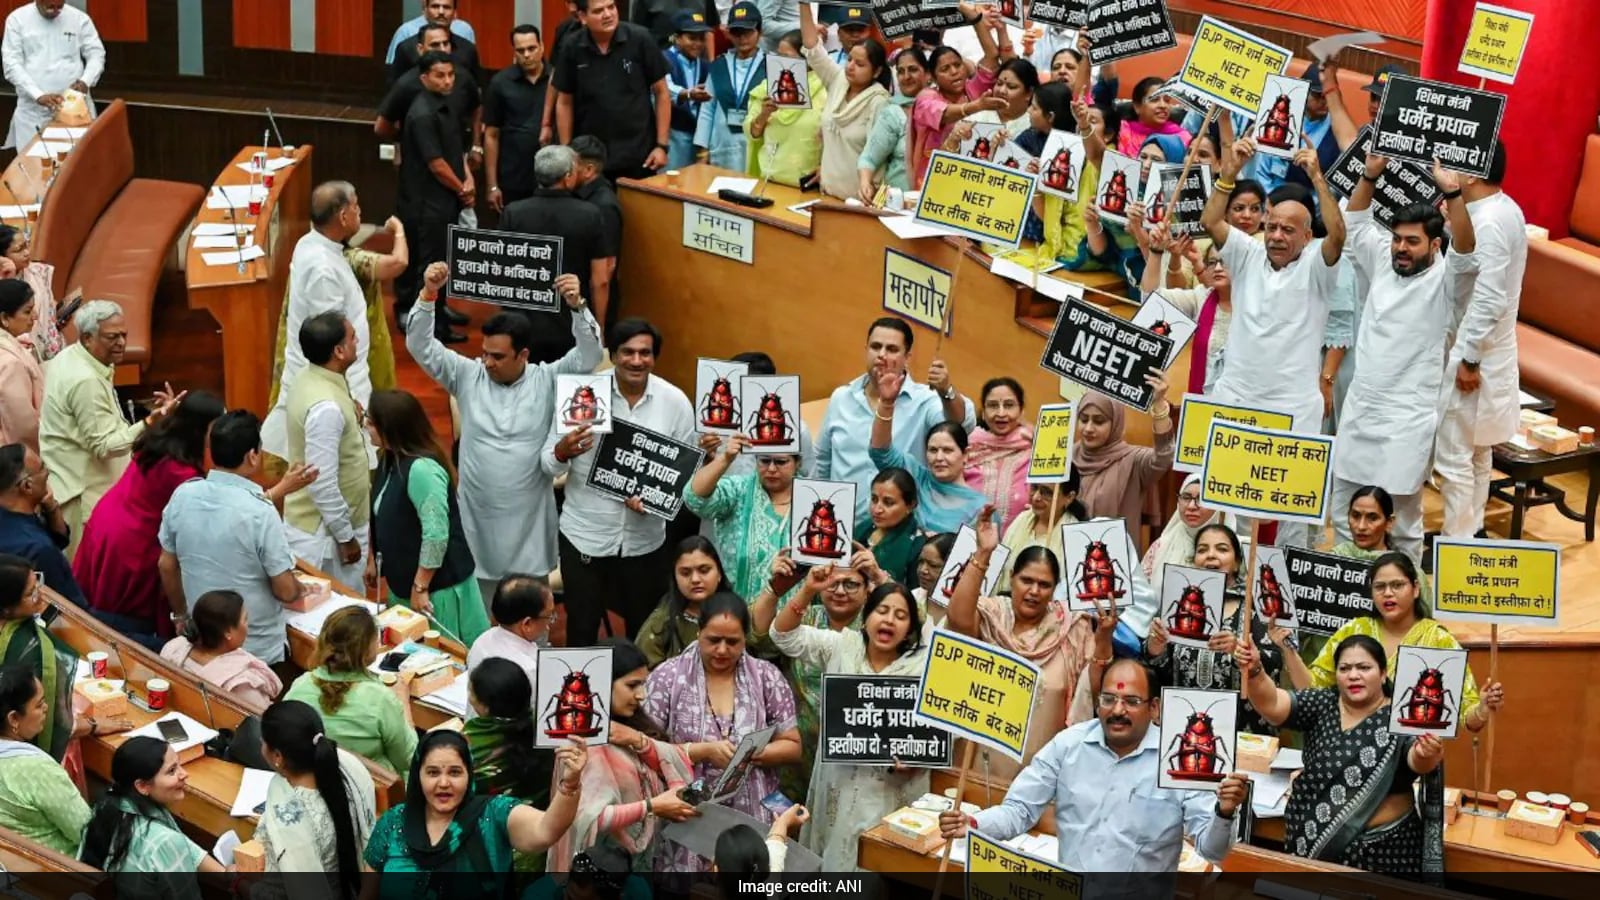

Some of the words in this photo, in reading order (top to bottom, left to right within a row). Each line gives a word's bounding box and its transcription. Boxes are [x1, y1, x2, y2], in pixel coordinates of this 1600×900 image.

[1201, 27, 1223, 44] BJP
[1221, 59, 1250, 79] NEET
[1415, 86, 1446, 105] शिक्षा
[1447, 95, 1472, 112] मंत्री
[1435, 115, 1480, 138] प्रधान
[934, 161, 958, 177] BJP
[960, 168, 985, 183] वालो
[987, 174, 1006, 189] शर्म
[1007, 180, 1030, 196] करो
[961, 190, 995, 208] NEET
[696, 207, 742, 235] निगम
[923, 197, 945, 215] पेपर
[946, 204, 972, 222] लीक
[994, 219, 1015, 234] करो
[457, 237, 477, 253] BJP
[478, 239, 505, 255] वालो
[506, 242, 529, 257] शर्म
[529, 244, 552, 260] करो
[692, 232, 744, 258] सचिव
[490, 261, 502, 276] के
[504, 264, 538, 280] भविष्य
[539, 266, 551, 282] के
[453, 279, 476, 293] साथ
[478, 280, 514, 298] खेलना
[531, 288, 554, 303] करो
[889, 274, 946, 320] महापौर
[1068, 307, 1089, 325] BJP
[1070, 329, 1141, 379] NEET
[631, 432, 660, 453] शिक्षा
[659, 444, 680, 461] मंत्री
[1214, 431, 1240, 449] BJP
[1243, 438, 1273, 456] वालो
[1277, 441, 1300, 459] शर्म
[1301, 446, 1327, 463] करो
[646, 460, 681, 486] प्रधान
[1250, 464, 1288, 483] NEET
[1207, 476, 1233, 495] पेपर
[1235, 482, 1264, 502] लीक
[1270, 487, 1289, 506] बंद
[1292, 490, 1317, 509] करो
[1291, 558, 1312, 575] BJP
[1313, 563, 1343, 581] वालो
[1343, 569, 1369, 585] शर्म
[1469, 552, 1496, 568] शिक्षा
[1498, 554, 1518, 569] मंत्री
[1324, 587, 1337, 604] के
[1491, 577, 1519, 588] प्रधान
[934, 642, 963, 662] BJP
[966, 652, 995, 675] वालो
[997, 665, 1017, 683] शर्म
[857, 681, 891, 699] शिक्षा
[893, 684, 918, 699] मंत्री
[969, 681, 1006, 707] NEET
[925, 688, 951, 713] पेपर
[952, 699, 980, 723] लीक
[985, 712, 1003, 733] बंद
[973, 841, 997, 862] BJP
[999, 855, 1028, 876] वालो
